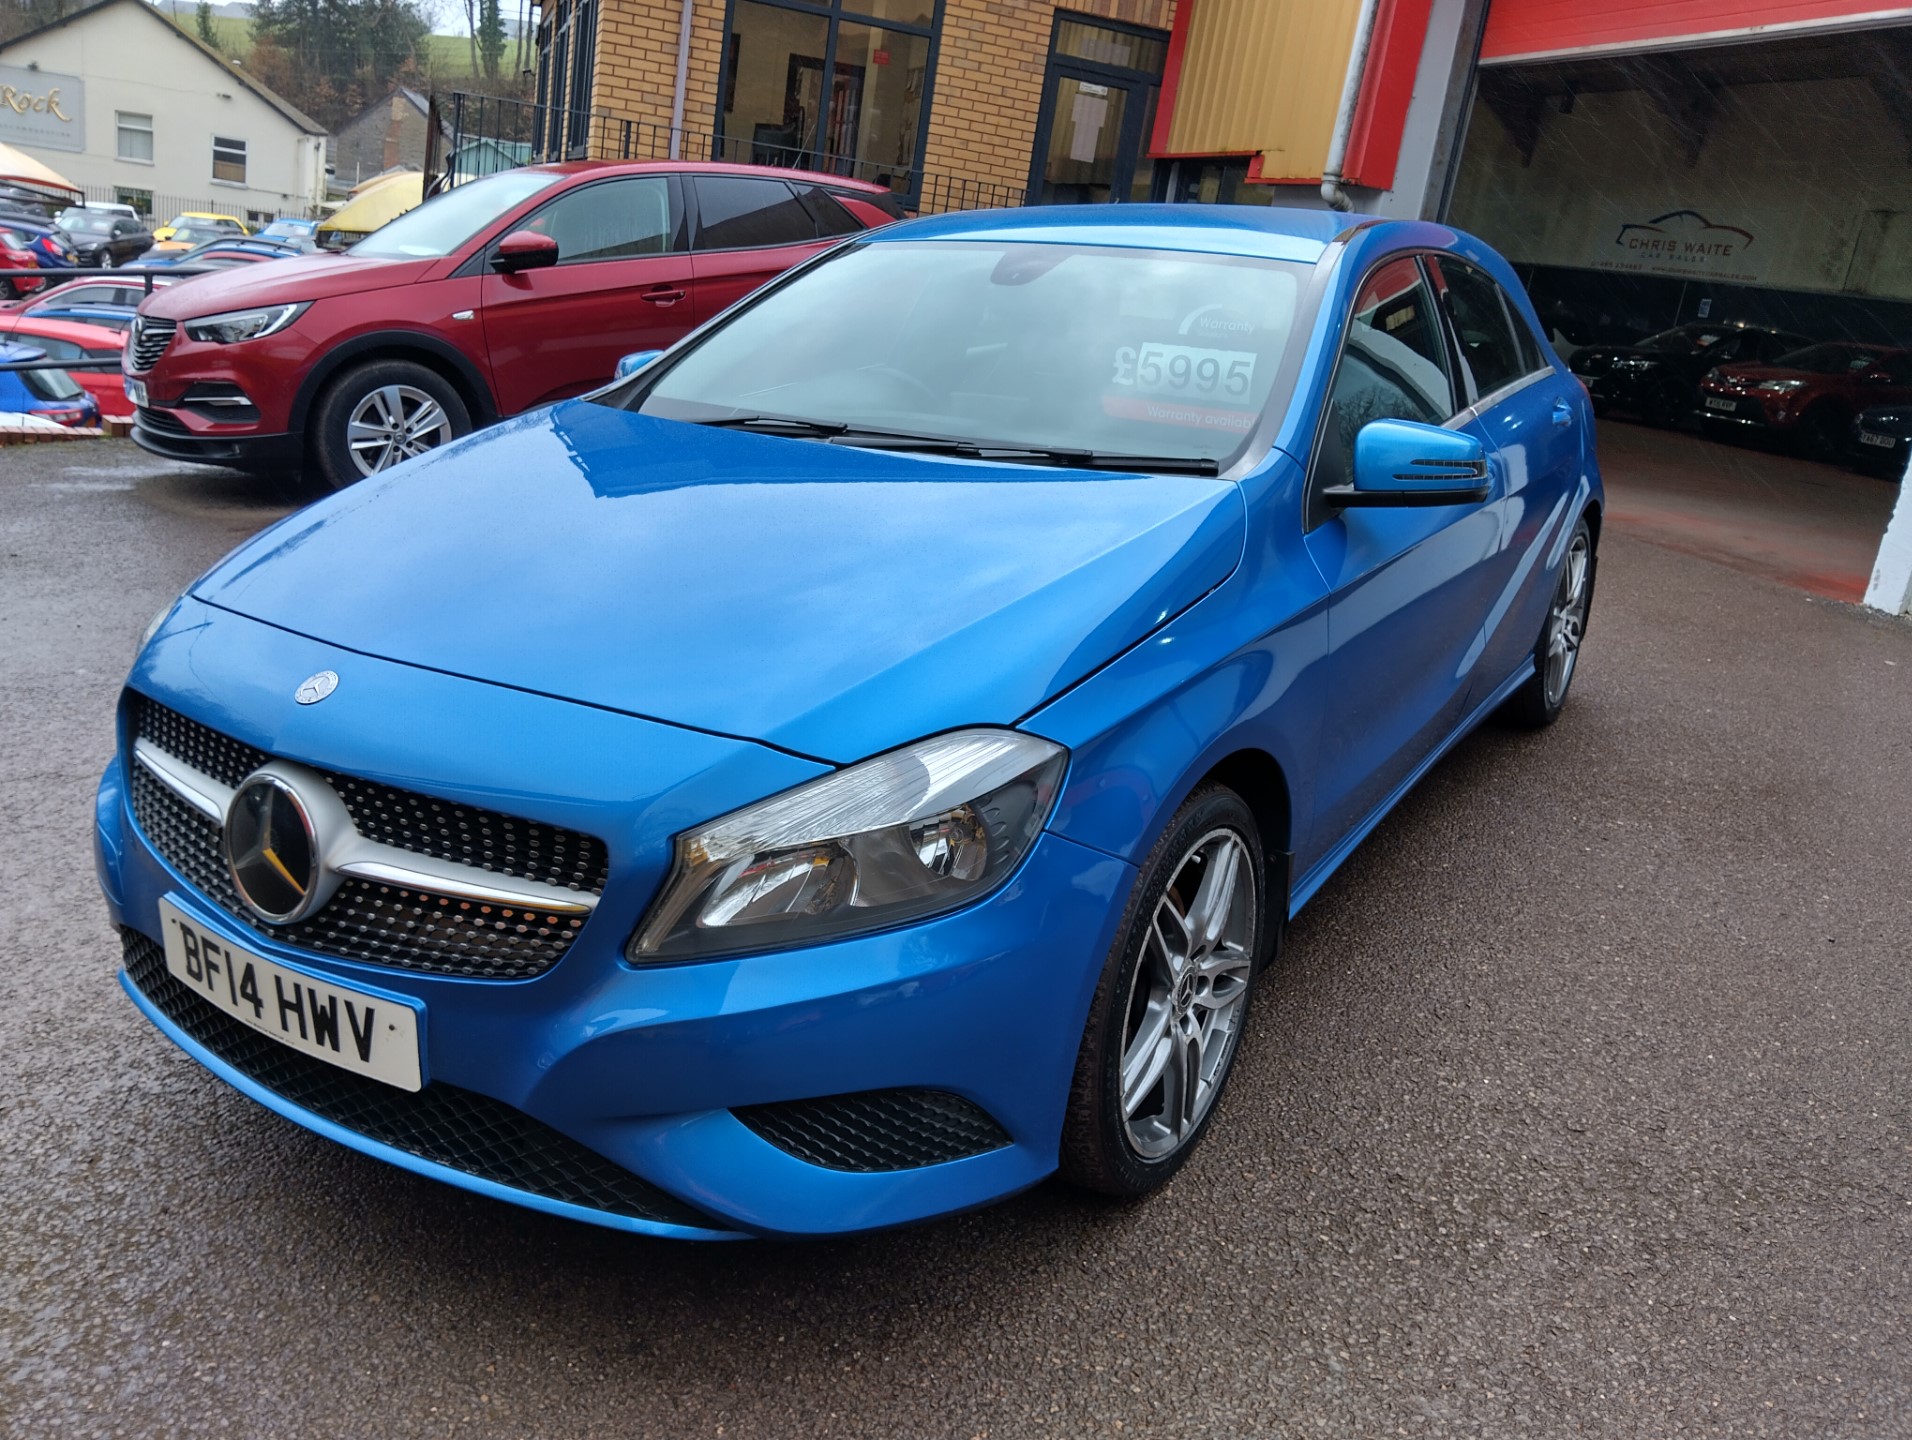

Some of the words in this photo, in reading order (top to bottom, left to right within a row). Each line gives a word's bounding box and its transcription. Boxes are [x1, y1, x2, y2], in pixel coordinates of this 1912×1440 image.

[1629, 238, 1678, 251] CHRIS
[1684, 241, 1733, 256] WAITE
[1199, 316, 1255, 332] Warranty
[1111, 346, 1252, 396] £5995
[1147, 406, 1202, 425] Warranty
[1204, 414, 1256, 430] availabl
[179, 921, 264, 1020] BF14
[274, 974, 376, 1063] HWV
